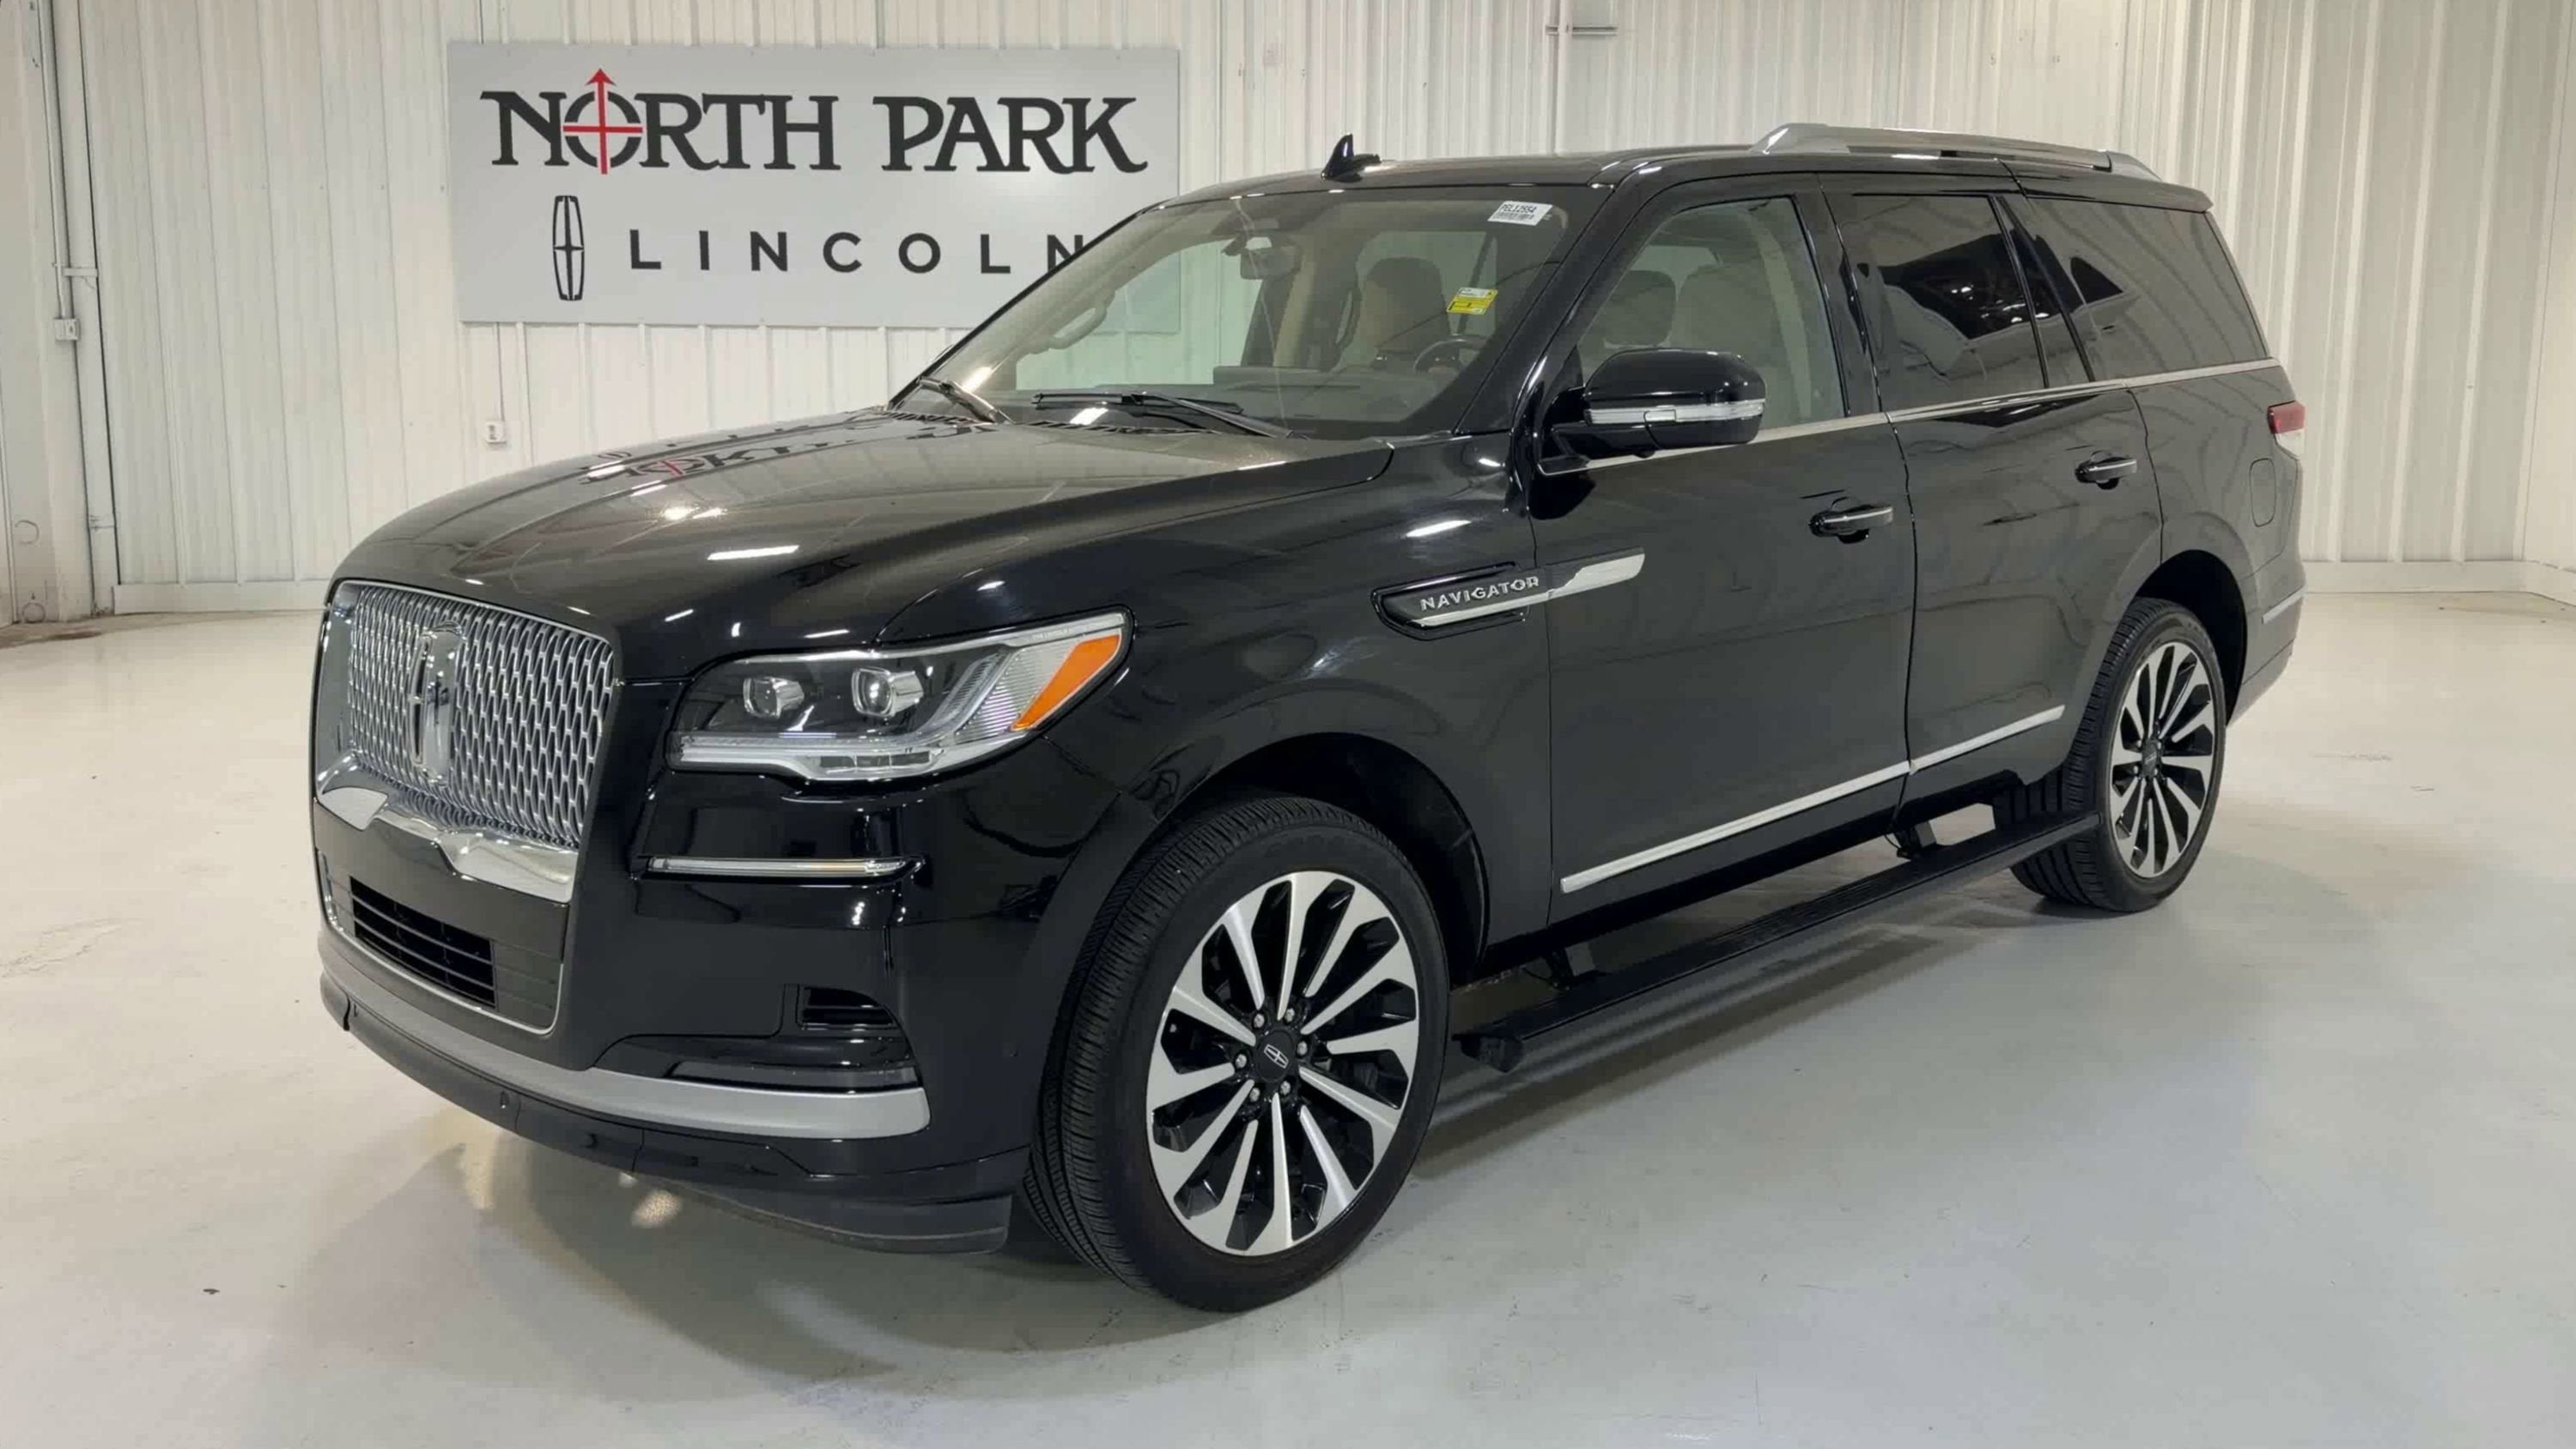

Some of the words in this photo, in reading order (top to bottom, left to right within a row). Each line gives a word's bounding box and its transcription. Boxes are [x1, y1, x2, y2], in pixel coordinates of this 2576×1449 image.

[479, 89, 841, 172] NORTH
[872, 95, 1149, 174] PARK
[629, 228, 1084, 275] LINCOLN
[1420, 575, 1540, 611] NAVIGATOR
